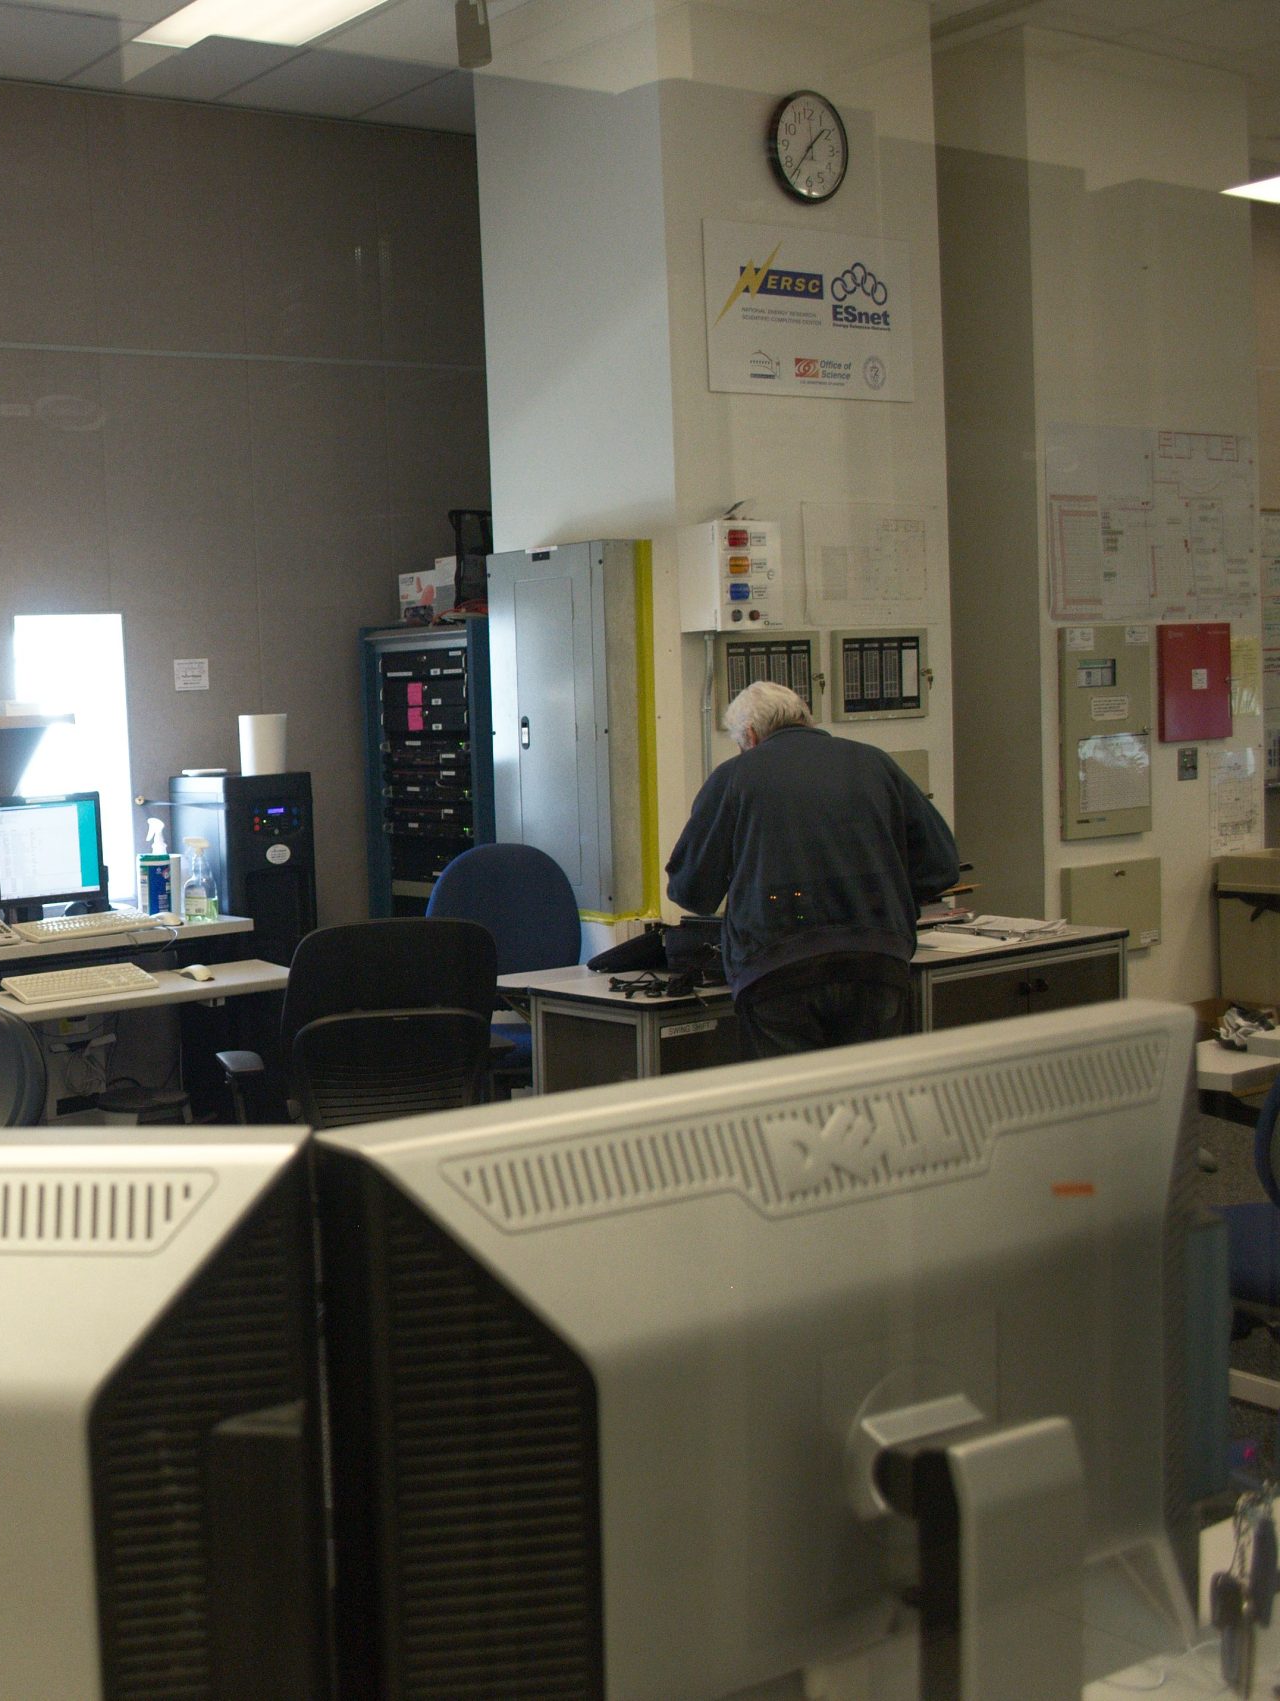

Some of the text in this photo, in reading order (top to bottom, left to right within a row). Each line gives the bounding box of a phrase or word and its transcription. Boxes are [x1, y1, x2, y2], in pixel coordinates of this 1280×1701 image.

[794, 111, 801, 124] 11
[803, 108, 815, 121] 12
[819, 114, 823, 127] 1
[785, 123, 797, 136] 10
[823, 128, 832, 141] 2
[781, 139, 789, 151] 9
[828, 145, 836, 157] 3
[785, 155, 794, 168] 8
[826, 162, 833, 173] 4
[805, 176, 813, 188] 6
[817, 172, 825, 184] 5
[832, 304, 890, 326] ESnet
[820, 360, 852, 370] Office of
[821, 372, 851, 381] Science
[669, 1021, 711, 1035] SWING SHIFT
[762, 1090, 966, 1195] DELL
